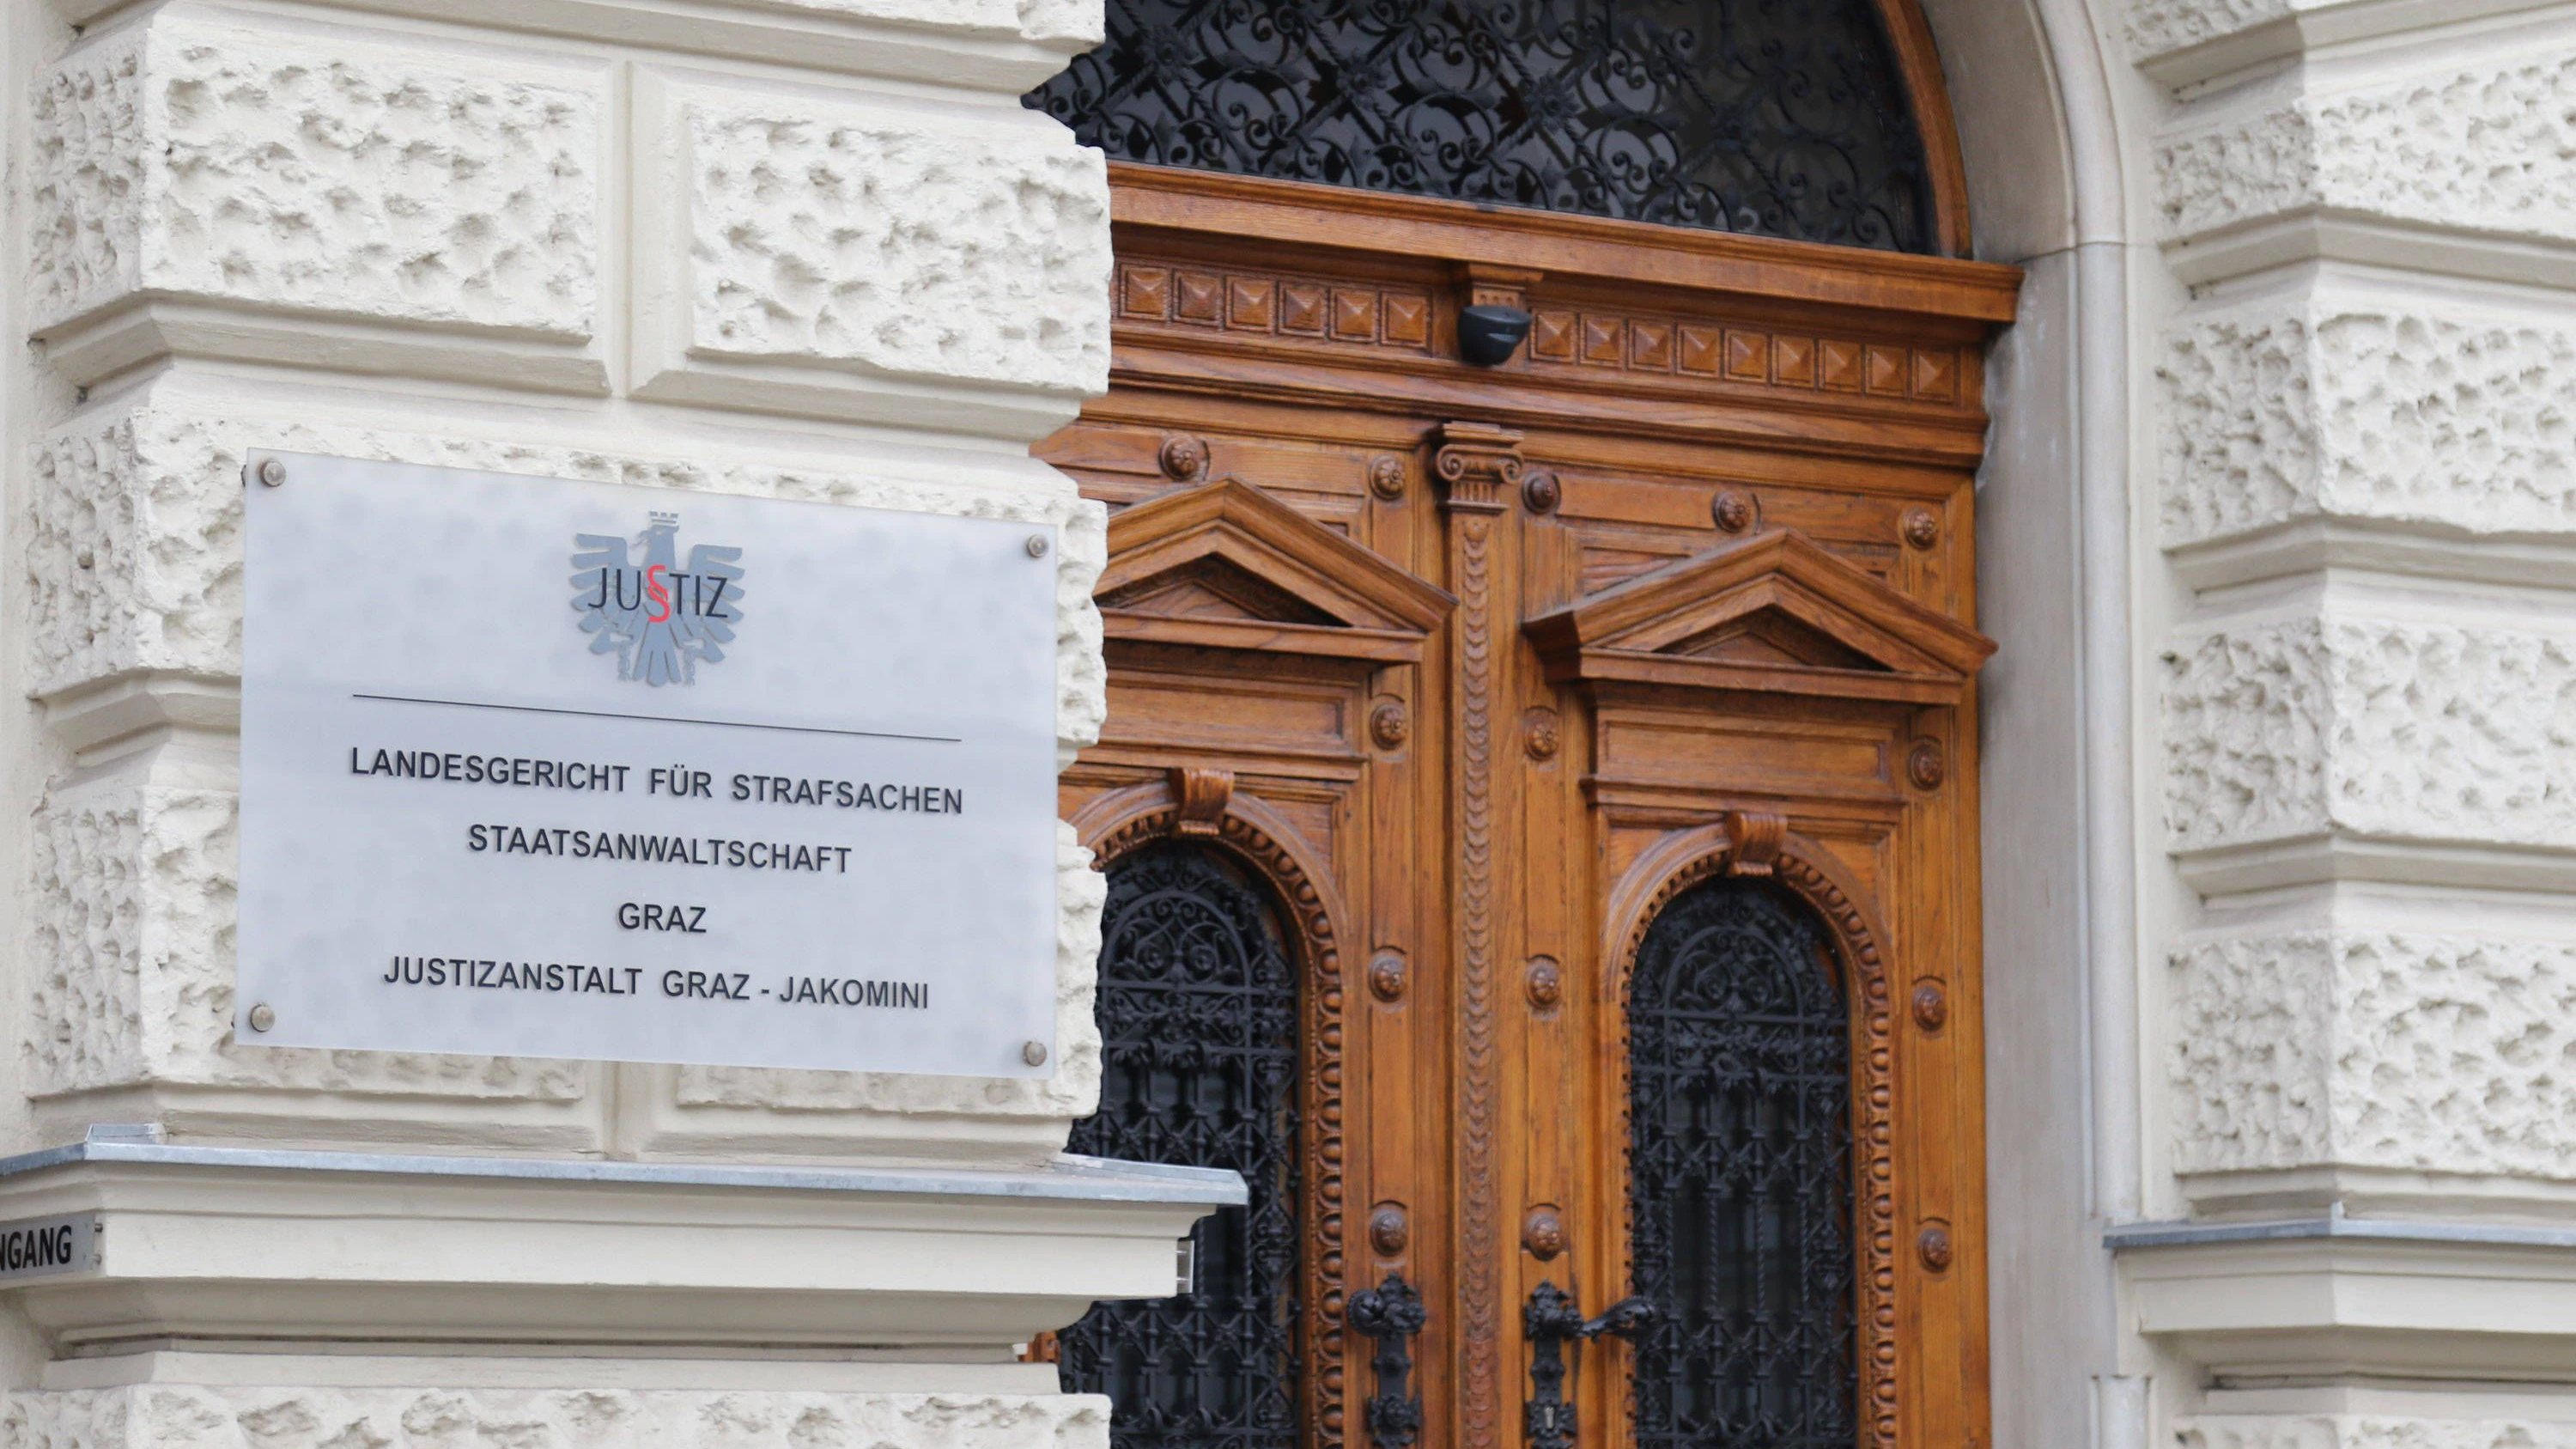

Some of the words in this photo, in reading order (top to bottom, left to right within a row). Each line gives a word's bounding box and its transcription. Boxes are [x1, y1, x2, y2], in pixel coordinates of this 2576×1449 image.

[351, 746, 630, 793] LANDESGERICHT
[649, 764, 713, 799] FÜR
[732, 774, 962, 815] STRAFSACHEN
[468, 823, 852, 874] STAATSANWALTSCHAFT
[617, 902, 707, 934] GRAZ
[383, 955, 643, 995] JUSTIZANSTALT
[662, 970, 750, 1001] GRAZ
[779, 977, 928, 1009] JAKOMINI
